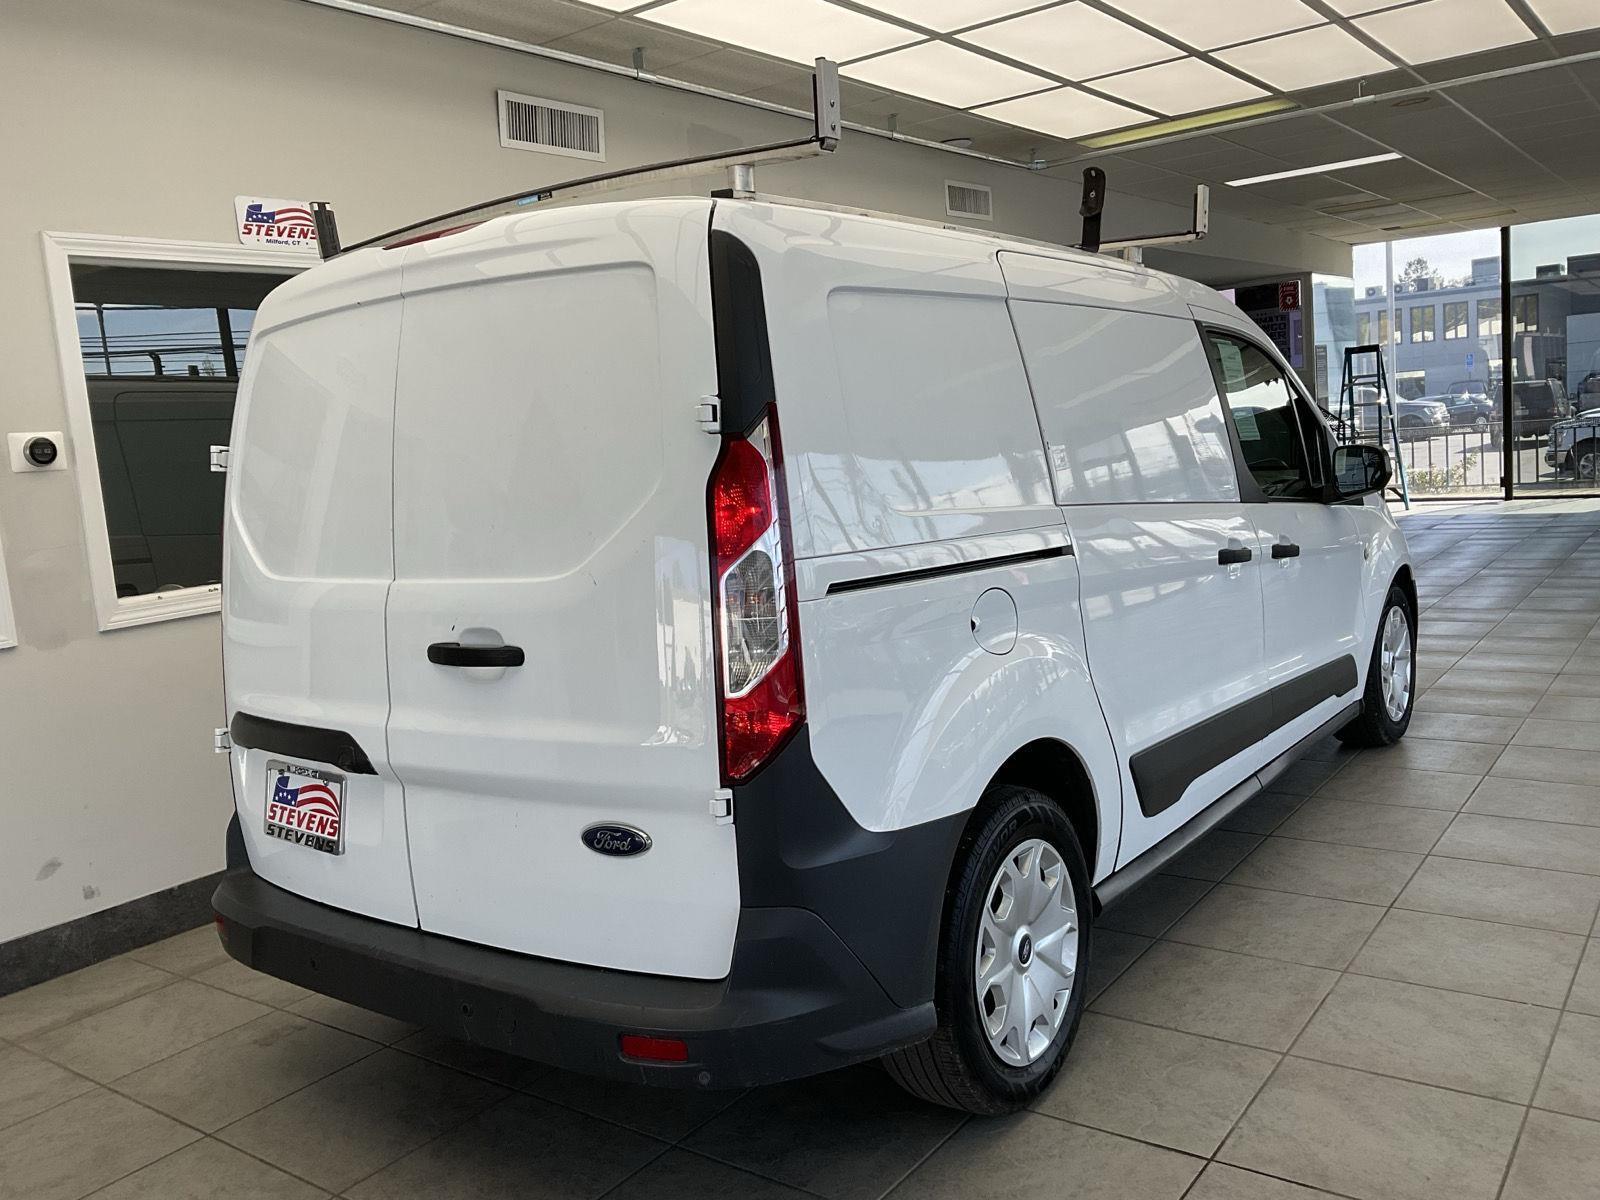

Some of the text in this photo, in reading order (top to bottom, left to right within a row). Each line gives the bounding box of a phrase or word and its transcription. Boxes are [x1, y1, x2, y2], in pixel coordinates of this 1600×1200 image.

[242, 224, 317, 240] STEVENS
[268, 803, 339, 837] STEVENS
[266, 823, 336, 853] STEVENS
[593, 830, 632, 851] Ford
